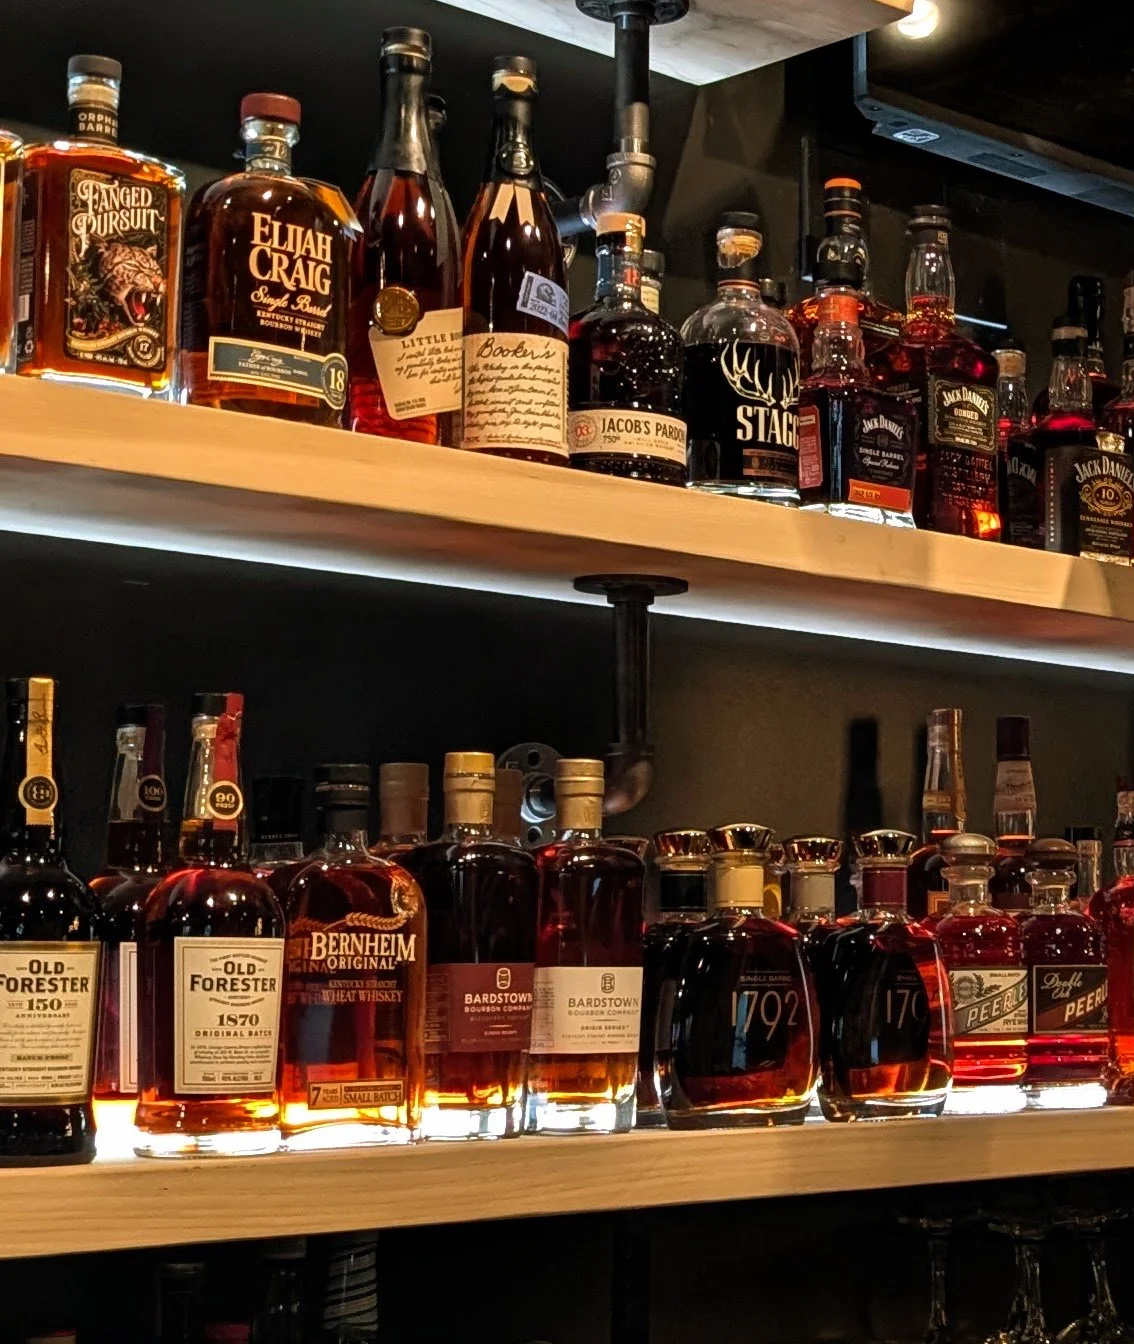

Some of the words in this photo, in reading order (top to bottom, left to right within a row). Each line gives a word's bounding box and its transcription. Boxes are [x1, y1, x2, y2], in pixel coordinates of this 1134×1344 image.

[76, 178, 153, 217] FANGED
[70, 207, 166, 259] PURSUIT
[250, 211, 334, 265] ELIJAH
[248, 244, 332, 296] CRAIG
[250, 285, 291, 312] Single
[291, 293, 333, 319] Barrel
[256, 309, 295, 325] KENTUCKY
[259, 318, 299, 333] BOURBON
[401, 333, 447, 350] LITTLE
[476, 337, 556, 360] Booker's
[328, 367, 346, 393] 18
[941, 389, 963, 408] JACK
[962, 385, 990, 417] DANIEL'S
[601, 417, 651, 436] JACOB'S
[862, 417, 879, 434] JACK
[879, 413, 905, 441] DANIEL'S
[858, 446, 880, 457] SINGLE
[881, 450, 905, 462] BARREL
[1073, 459, 1102, 484] JACK
[1101, 488, 1115, 500] 10
[215, 792, 237, 805] 90
[310, 931, 417, 962] BERNHEIM
[28, 959, 65, 975] OLD
[223, 960, 257, 976] OLD
[326, 955, 396, 971] ORIGINAL
[189, 974, 277, 993] FORESTER
[26, 997, 63, 1011] 150
[321, 989, 358, 1003] WHEAT
[359, 989, 403, 1003] WHISKEY
[464, 993, 533, 1005] BARDSTOWN
[568, 997, 639, 1008] BARDSTOWN
[966, 982, 1027, 1028] PEERLE
[1063, 979, 1108, 1023] PEERL
[567, 1009, 605, 1017] BOURBON
[732, 989, 799, 1042] 1792
[886, 988, 928, 1032] 179
[216, 1013, 260, 1027] 1870
[311, 1086, 322, 1106] 7
[343, 1092, 373, 1104] SMALL
[373, 1090, 401, 1102] BATCH
